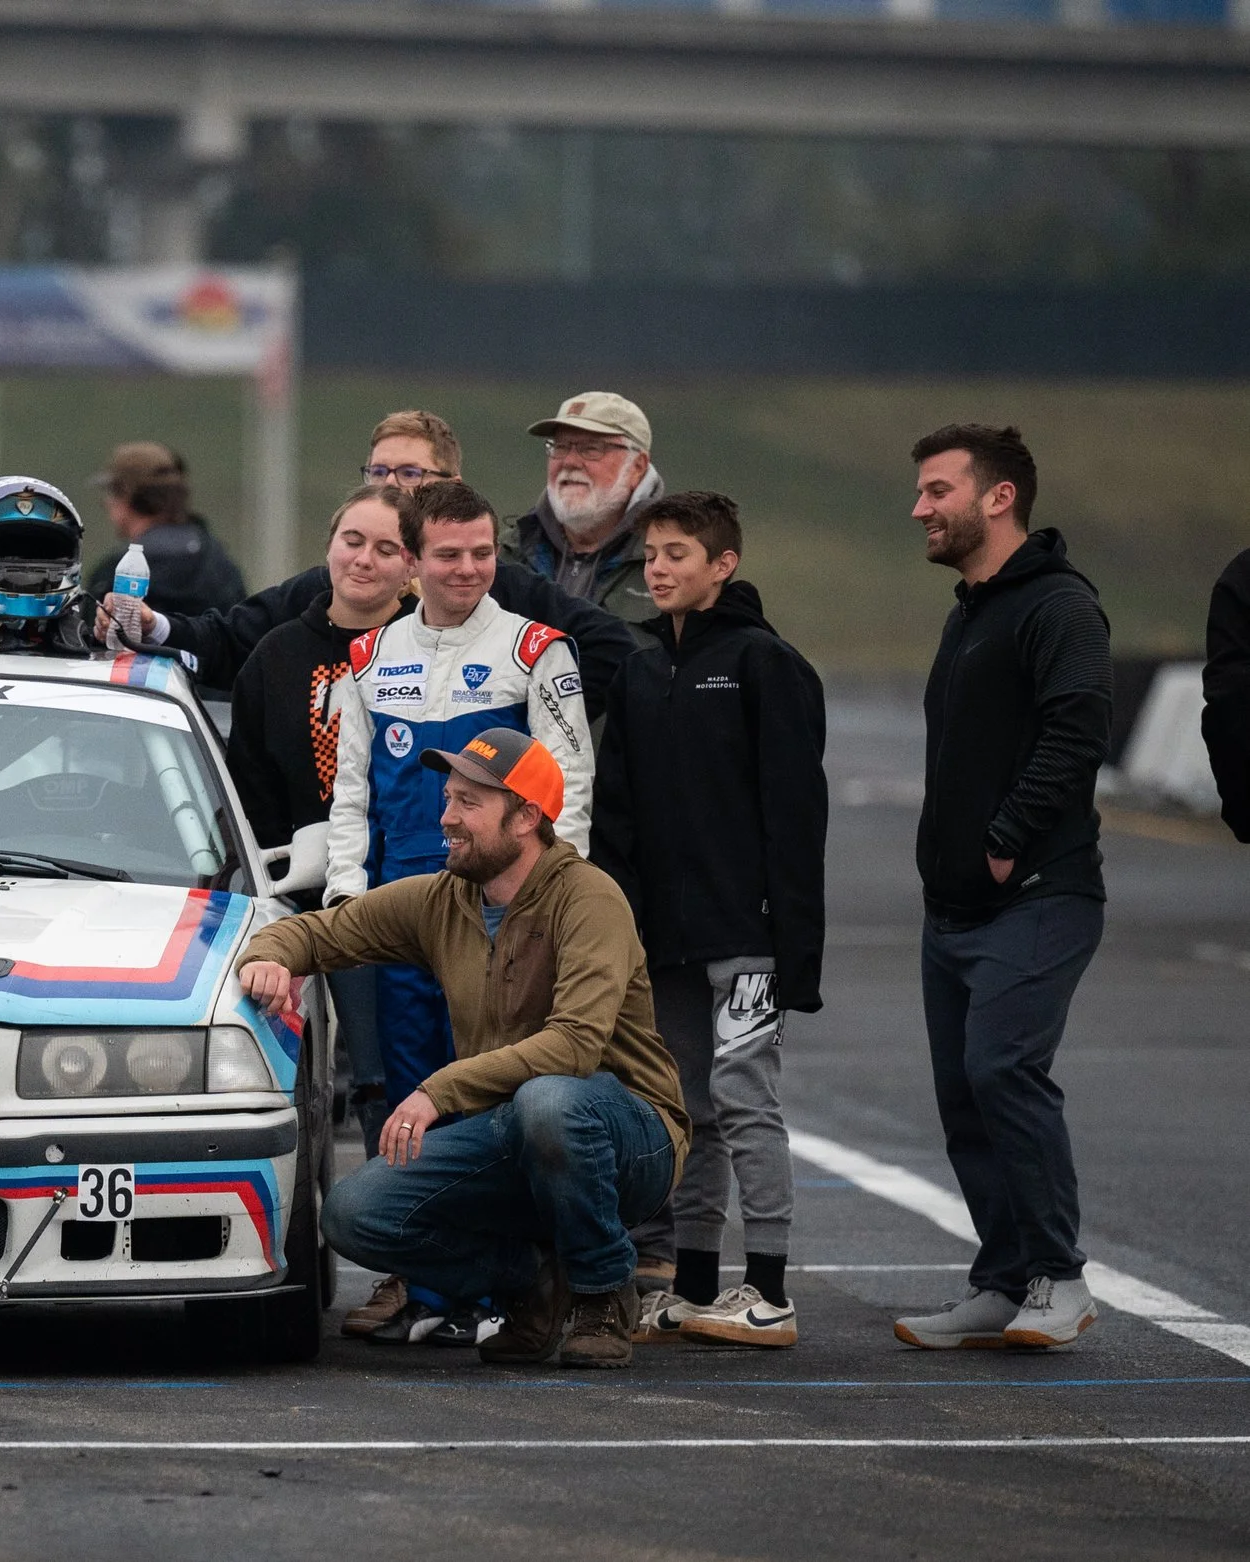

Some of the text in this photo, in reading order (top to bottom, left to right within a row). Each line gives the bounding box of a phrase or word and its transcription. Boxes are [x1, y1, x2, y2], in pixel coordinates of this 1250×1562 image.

[377, 664, 423, 677] mazda
[464, 667, 487, 682] BM
[376, 686, 422, 698] SCCA
[80, 1168, 132, 1218] 36
